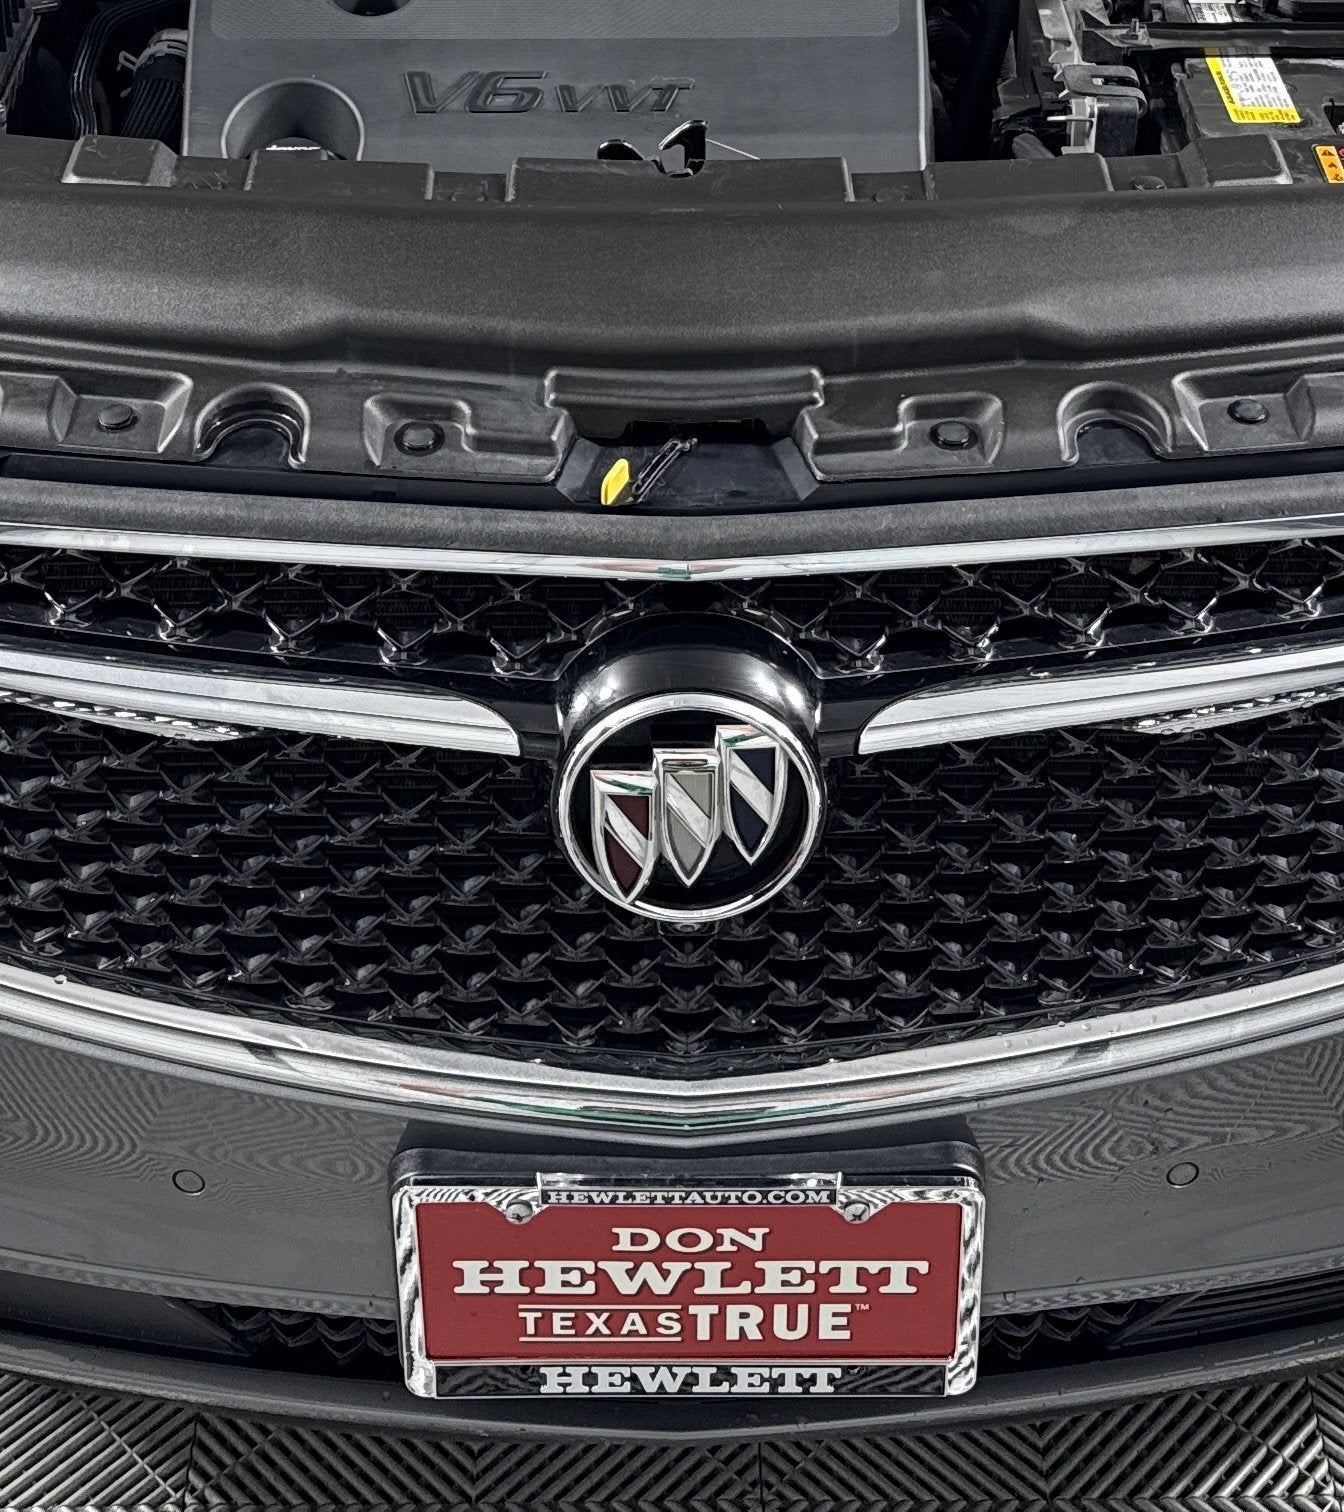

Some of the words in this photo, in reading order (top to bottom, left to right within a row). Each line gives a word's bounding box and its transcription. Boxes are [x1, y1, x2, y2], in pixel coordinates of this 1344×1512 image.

[403, 71, 548, 113] V6
[556, 77, 696, 113] VVT
[547, 1190, 832, 1205] HEWLETTAUTO.COM
[611, 1227, 771, 1253] DON
[452, 1260, 930, 1295] HEWLETT
[539, 1366, 843, 1395] HEWLETT
